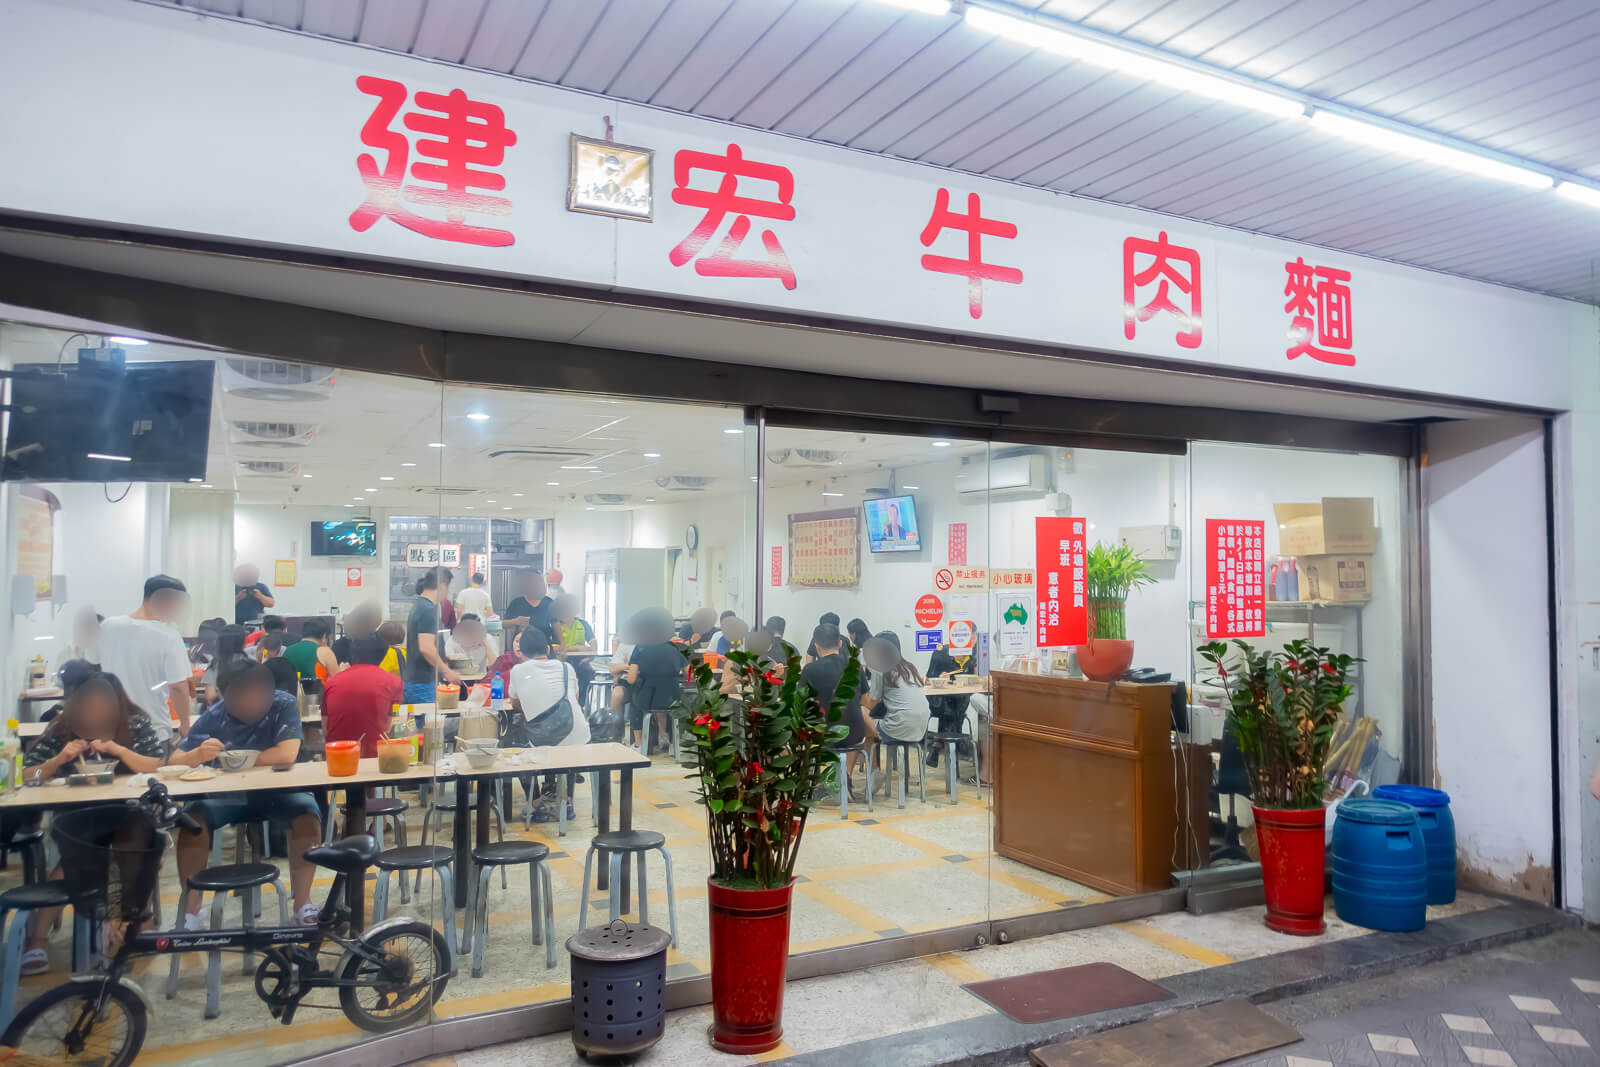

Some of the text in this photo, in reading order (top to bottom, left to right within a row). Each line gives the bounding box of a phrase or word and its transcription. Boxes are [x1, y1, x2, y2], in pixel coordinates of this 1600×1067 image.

[349, 75, 1356, 367] 建宏牛肉麵
[993, 573, 1034, 584] 小心玻璃
